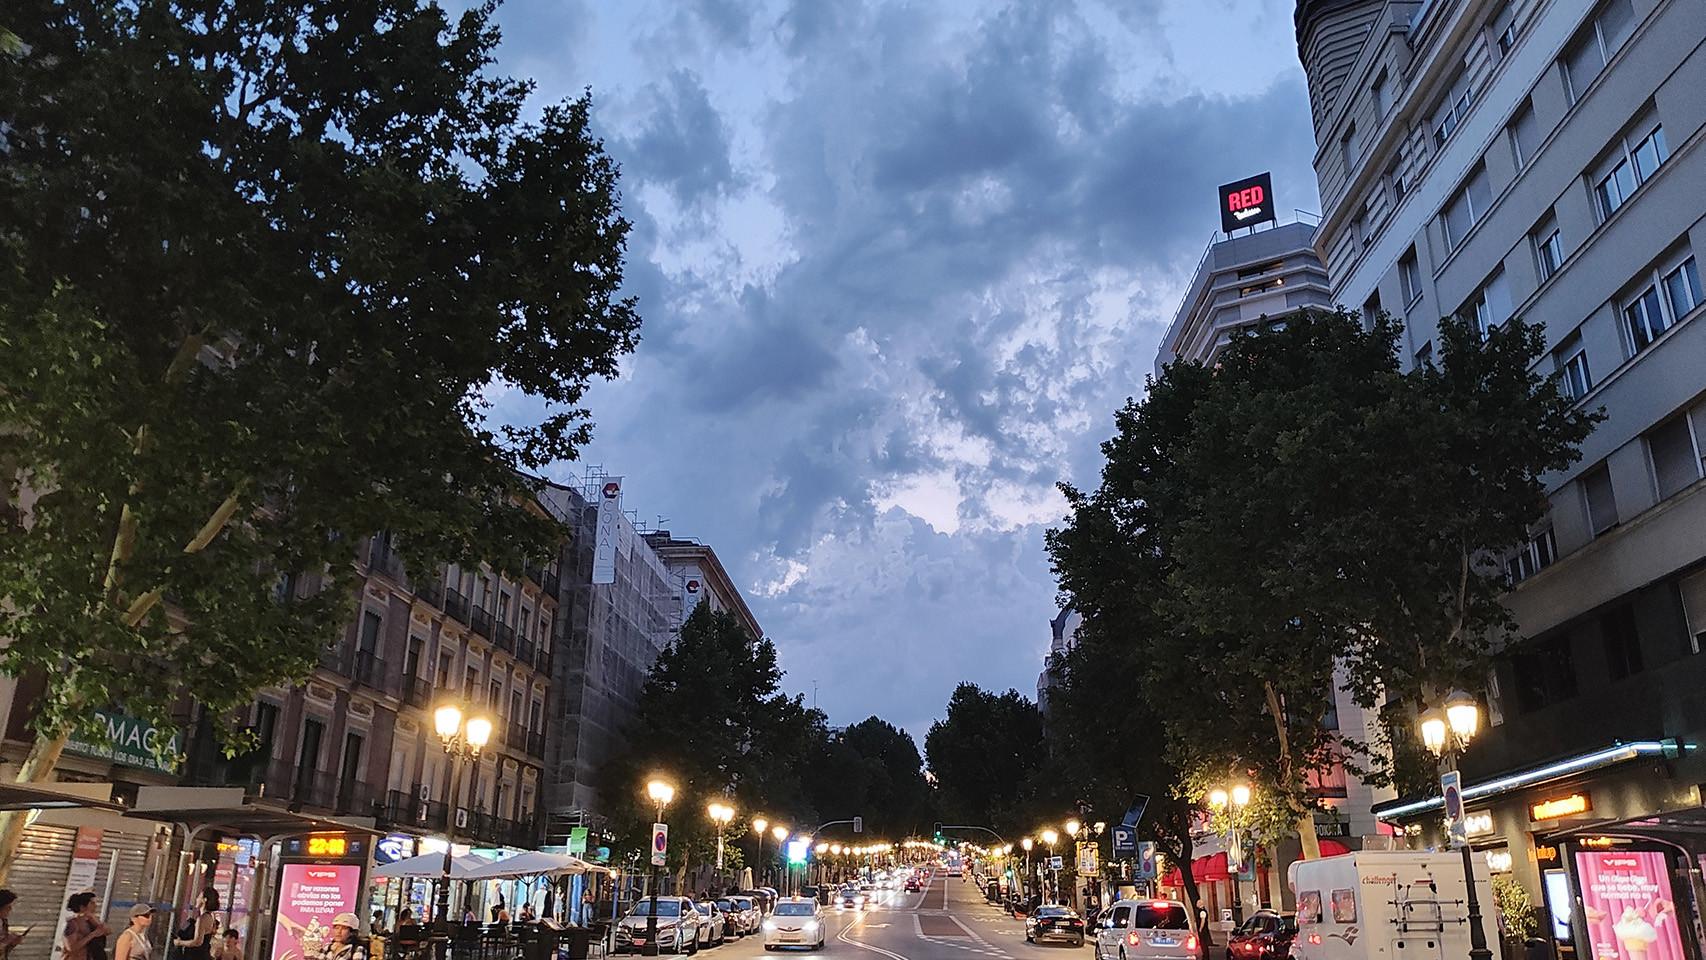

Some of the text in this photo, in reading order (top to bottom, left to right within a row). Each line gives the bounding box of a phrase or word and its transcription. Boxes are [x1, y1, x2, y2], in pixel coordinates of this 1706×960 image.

[1228, 185, 1264, 211] RED
[599, 500, 613, 560] CONAL
[114, 751, 127, 761] LOS
[1115, 831, 1128, 846] P
[331, 892, 341, 900] los
[291, 899, 344, 908] podemos poner
